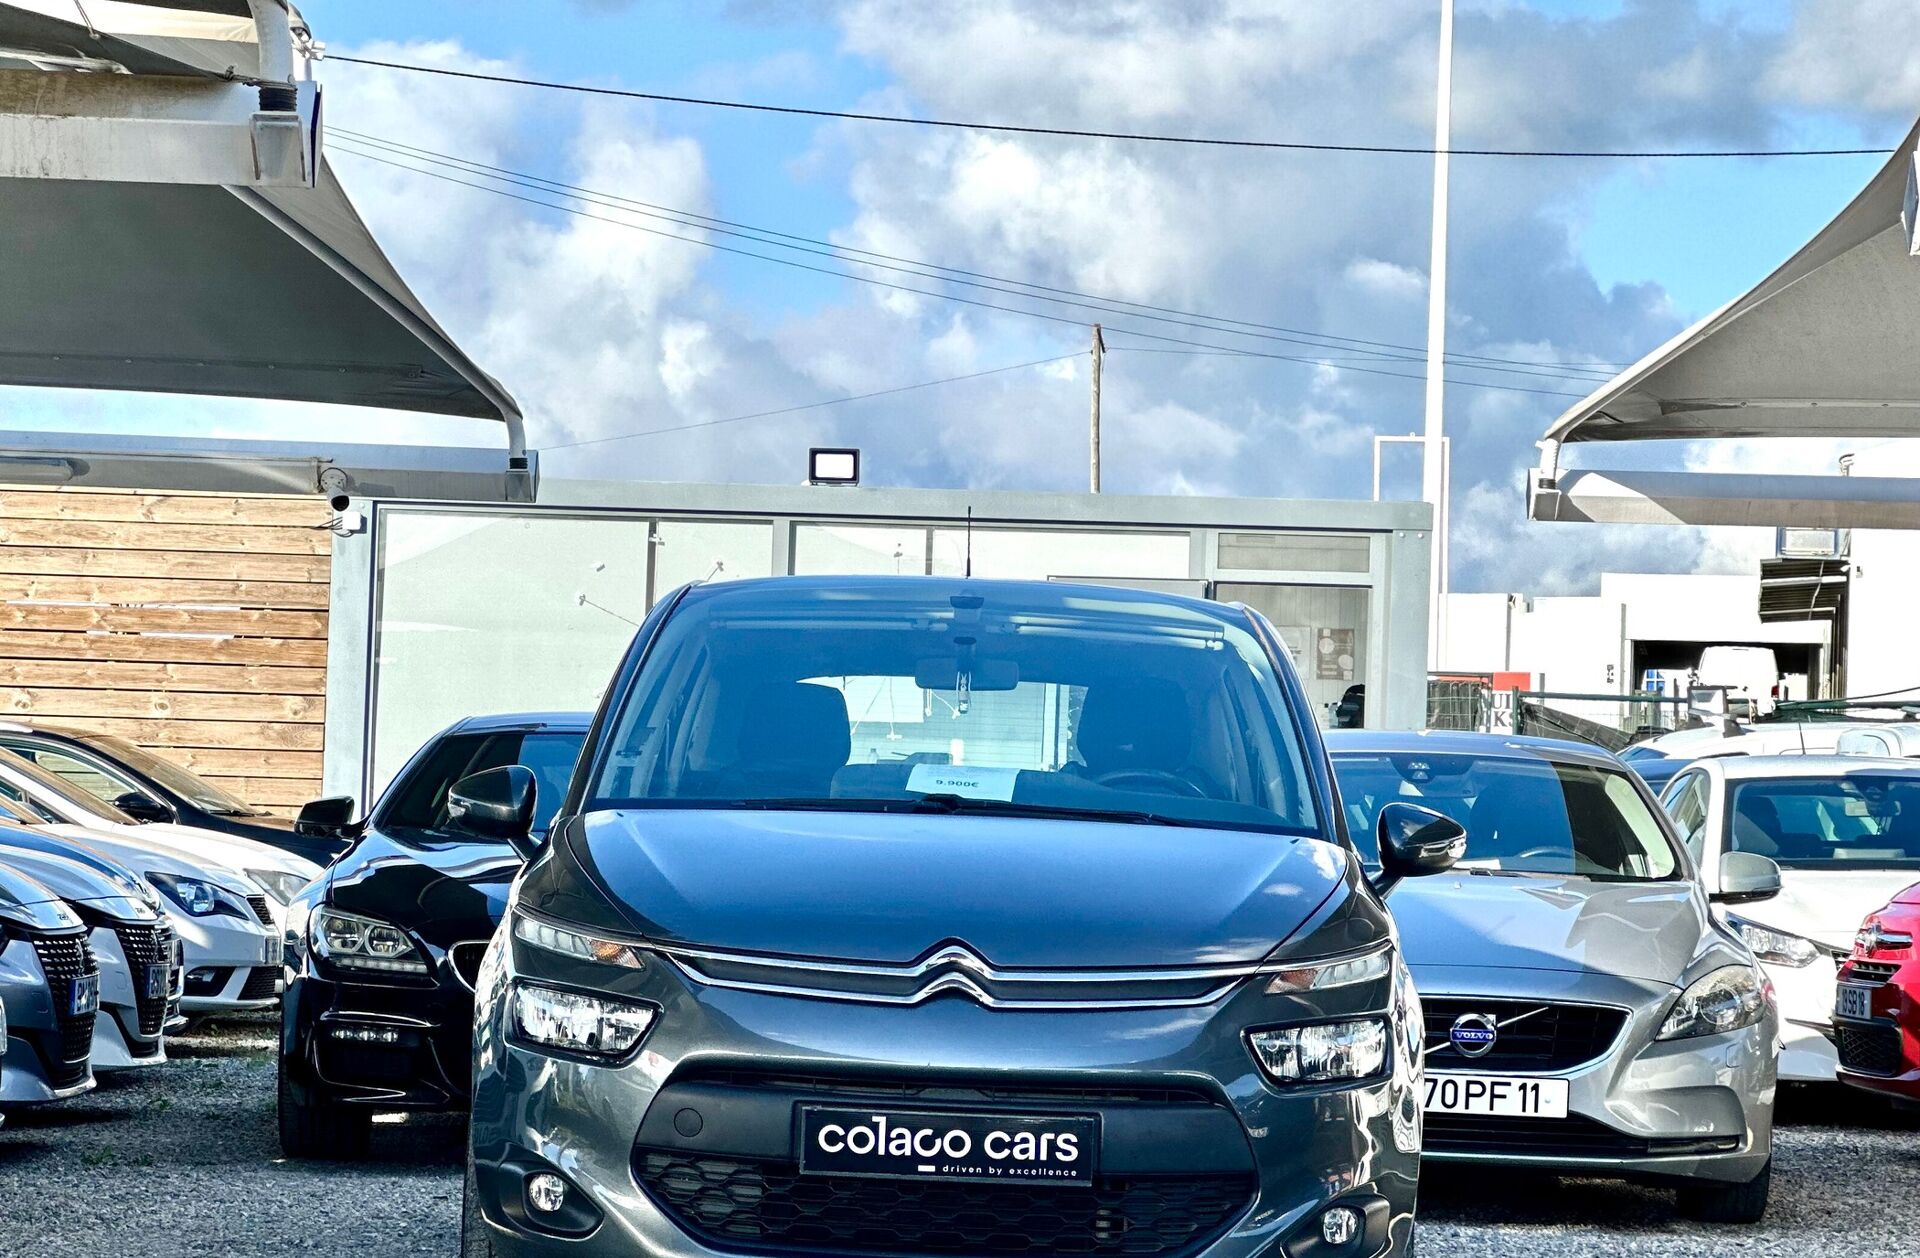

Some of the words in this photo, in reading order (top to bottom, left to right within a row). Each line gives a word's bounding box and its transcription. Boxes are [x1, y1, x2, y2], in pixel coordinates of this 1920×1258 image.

[936, 779, 979, 788] 9.900€
[1454, 1031, 1494, 1040] VOLVO
[983, 1130, 1079, 1162] cars
[942, 1165, 982, 1174] driven
[988, 1166, 1003, 1176] by
[1009, 1167, 1078, 1177] excellence
